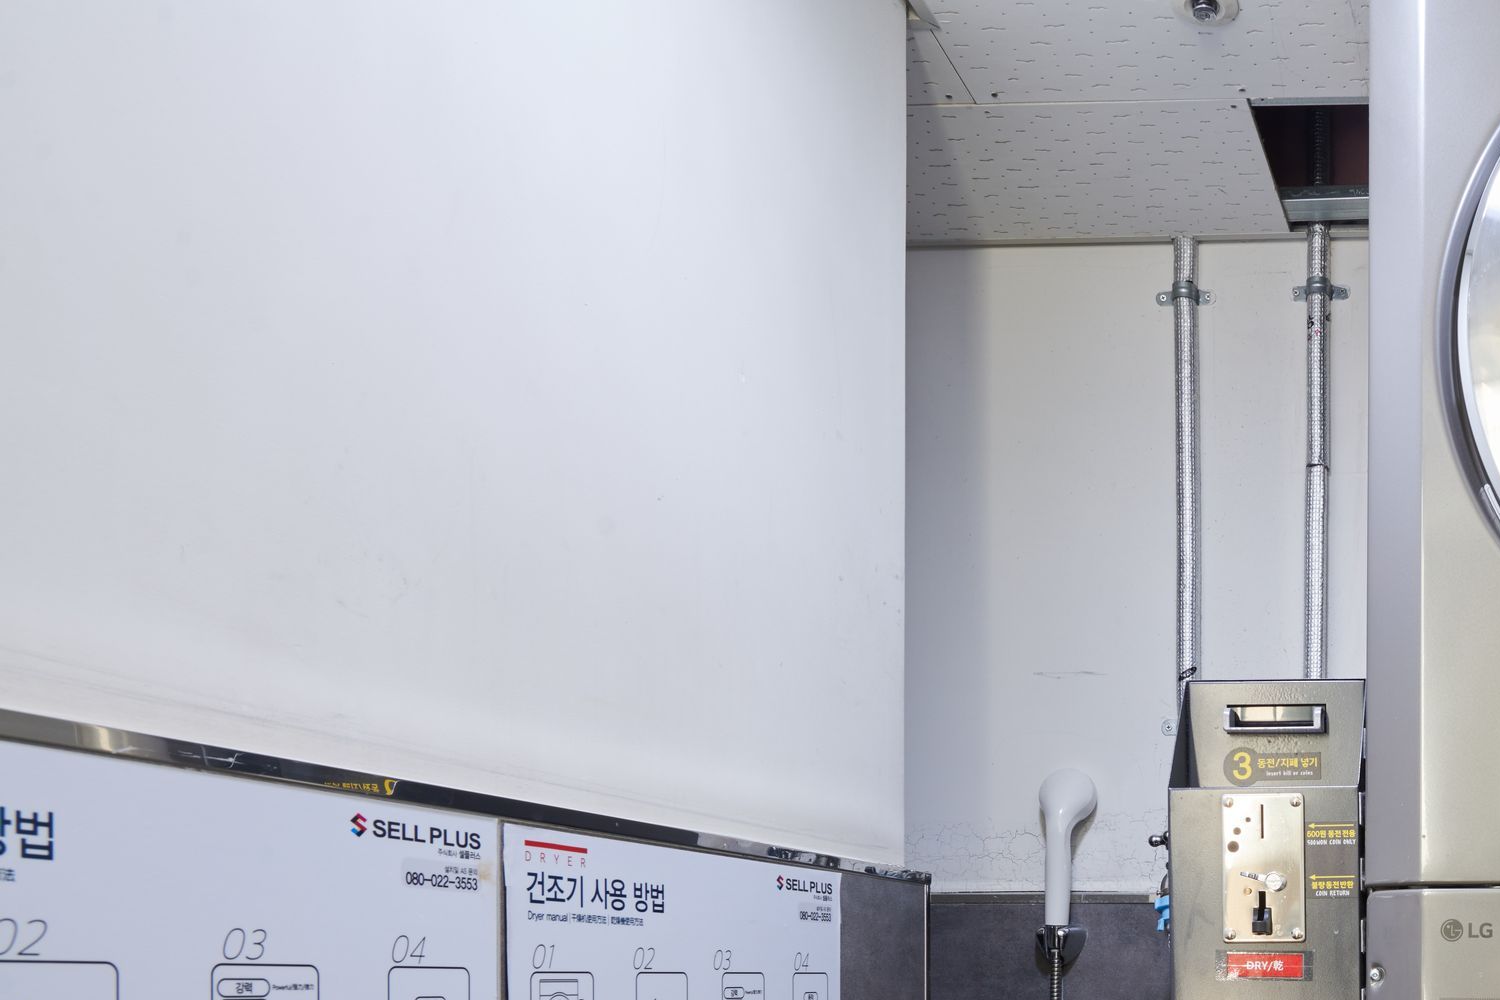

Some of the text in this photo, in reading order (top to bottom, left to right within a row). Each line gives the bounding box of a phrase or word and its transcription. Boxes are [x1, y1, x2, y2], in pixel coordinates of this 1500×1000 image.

[1233, 752, 1252, 780] 3
[1258, 758, 1317, 768] 동전/지폐 넣기
[0, 806, 53, 860] 법
[372, 819, 481, 849] SELL PLUS
[525, 851, 586, 868] DRYER
[406, 872, 478, 890] 080-022-3553
[786, 879, 832, 894] SELL PLUS
[527, 872, 664, 913] 건조기 사용 방법
[528, 911, 567, 922] Dryer manual
[1468, 923, 1493, 938] LG
[222, 927, 267, 960] 03
[392, 935, 426, 964] 04
[533, 944, 555, 969] 01
[633, 947, 655, 970] 02
[713, 949, 732, 970] 03
[794, 952, 809, 971] 04
